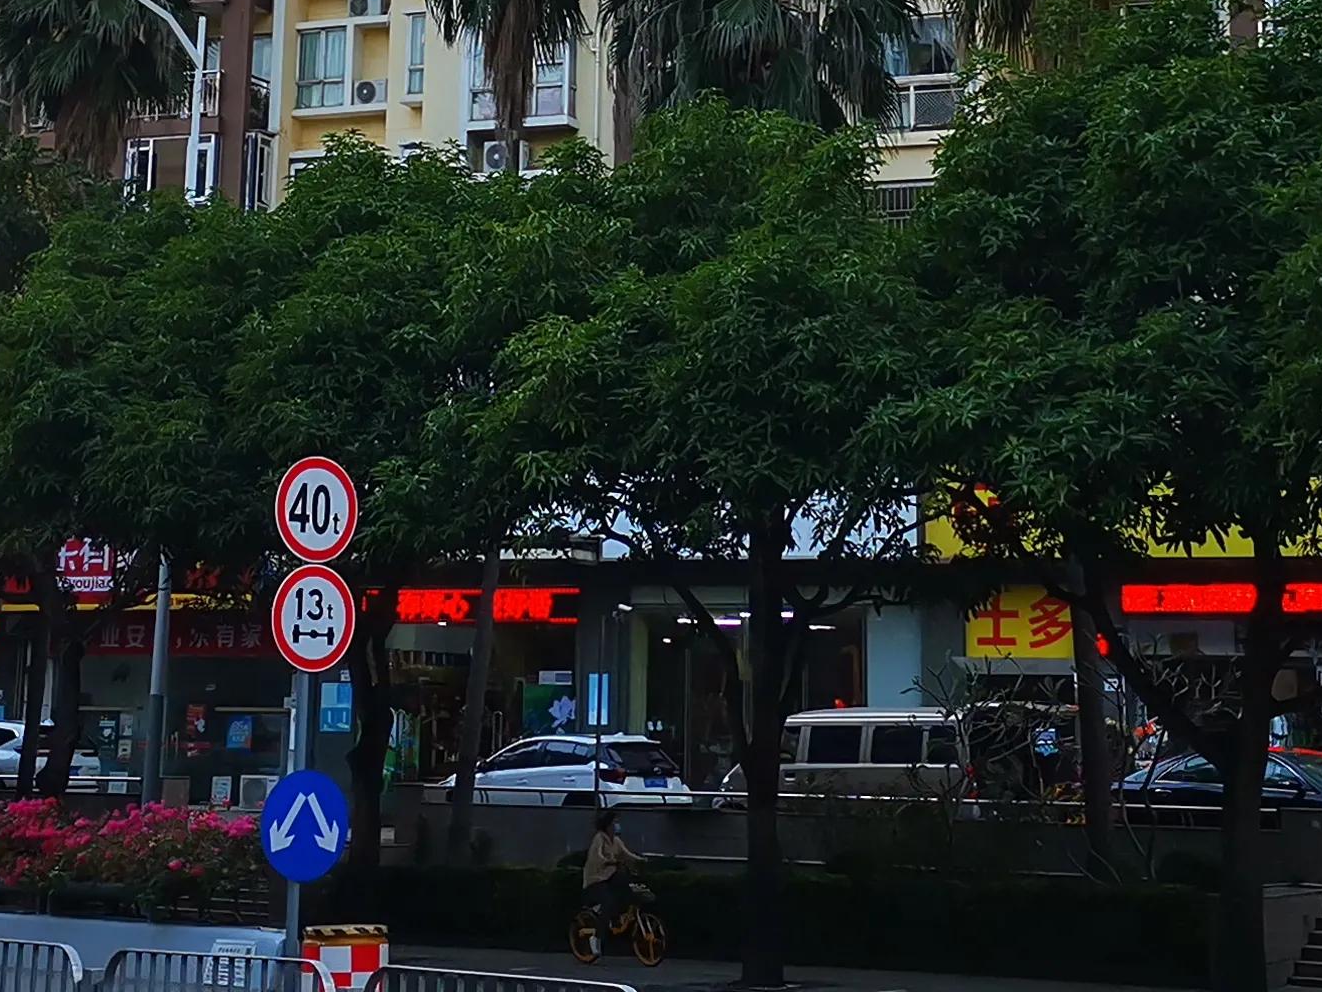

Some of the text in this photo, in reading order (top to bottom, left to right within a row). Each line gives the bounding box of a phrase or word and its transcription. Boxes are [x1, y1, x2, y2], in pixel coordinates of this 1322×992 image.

[289, 482, 340, 535] 40t
[295, 587, 334, 620] 13t
[976, 594, 1073, 649] 士多
